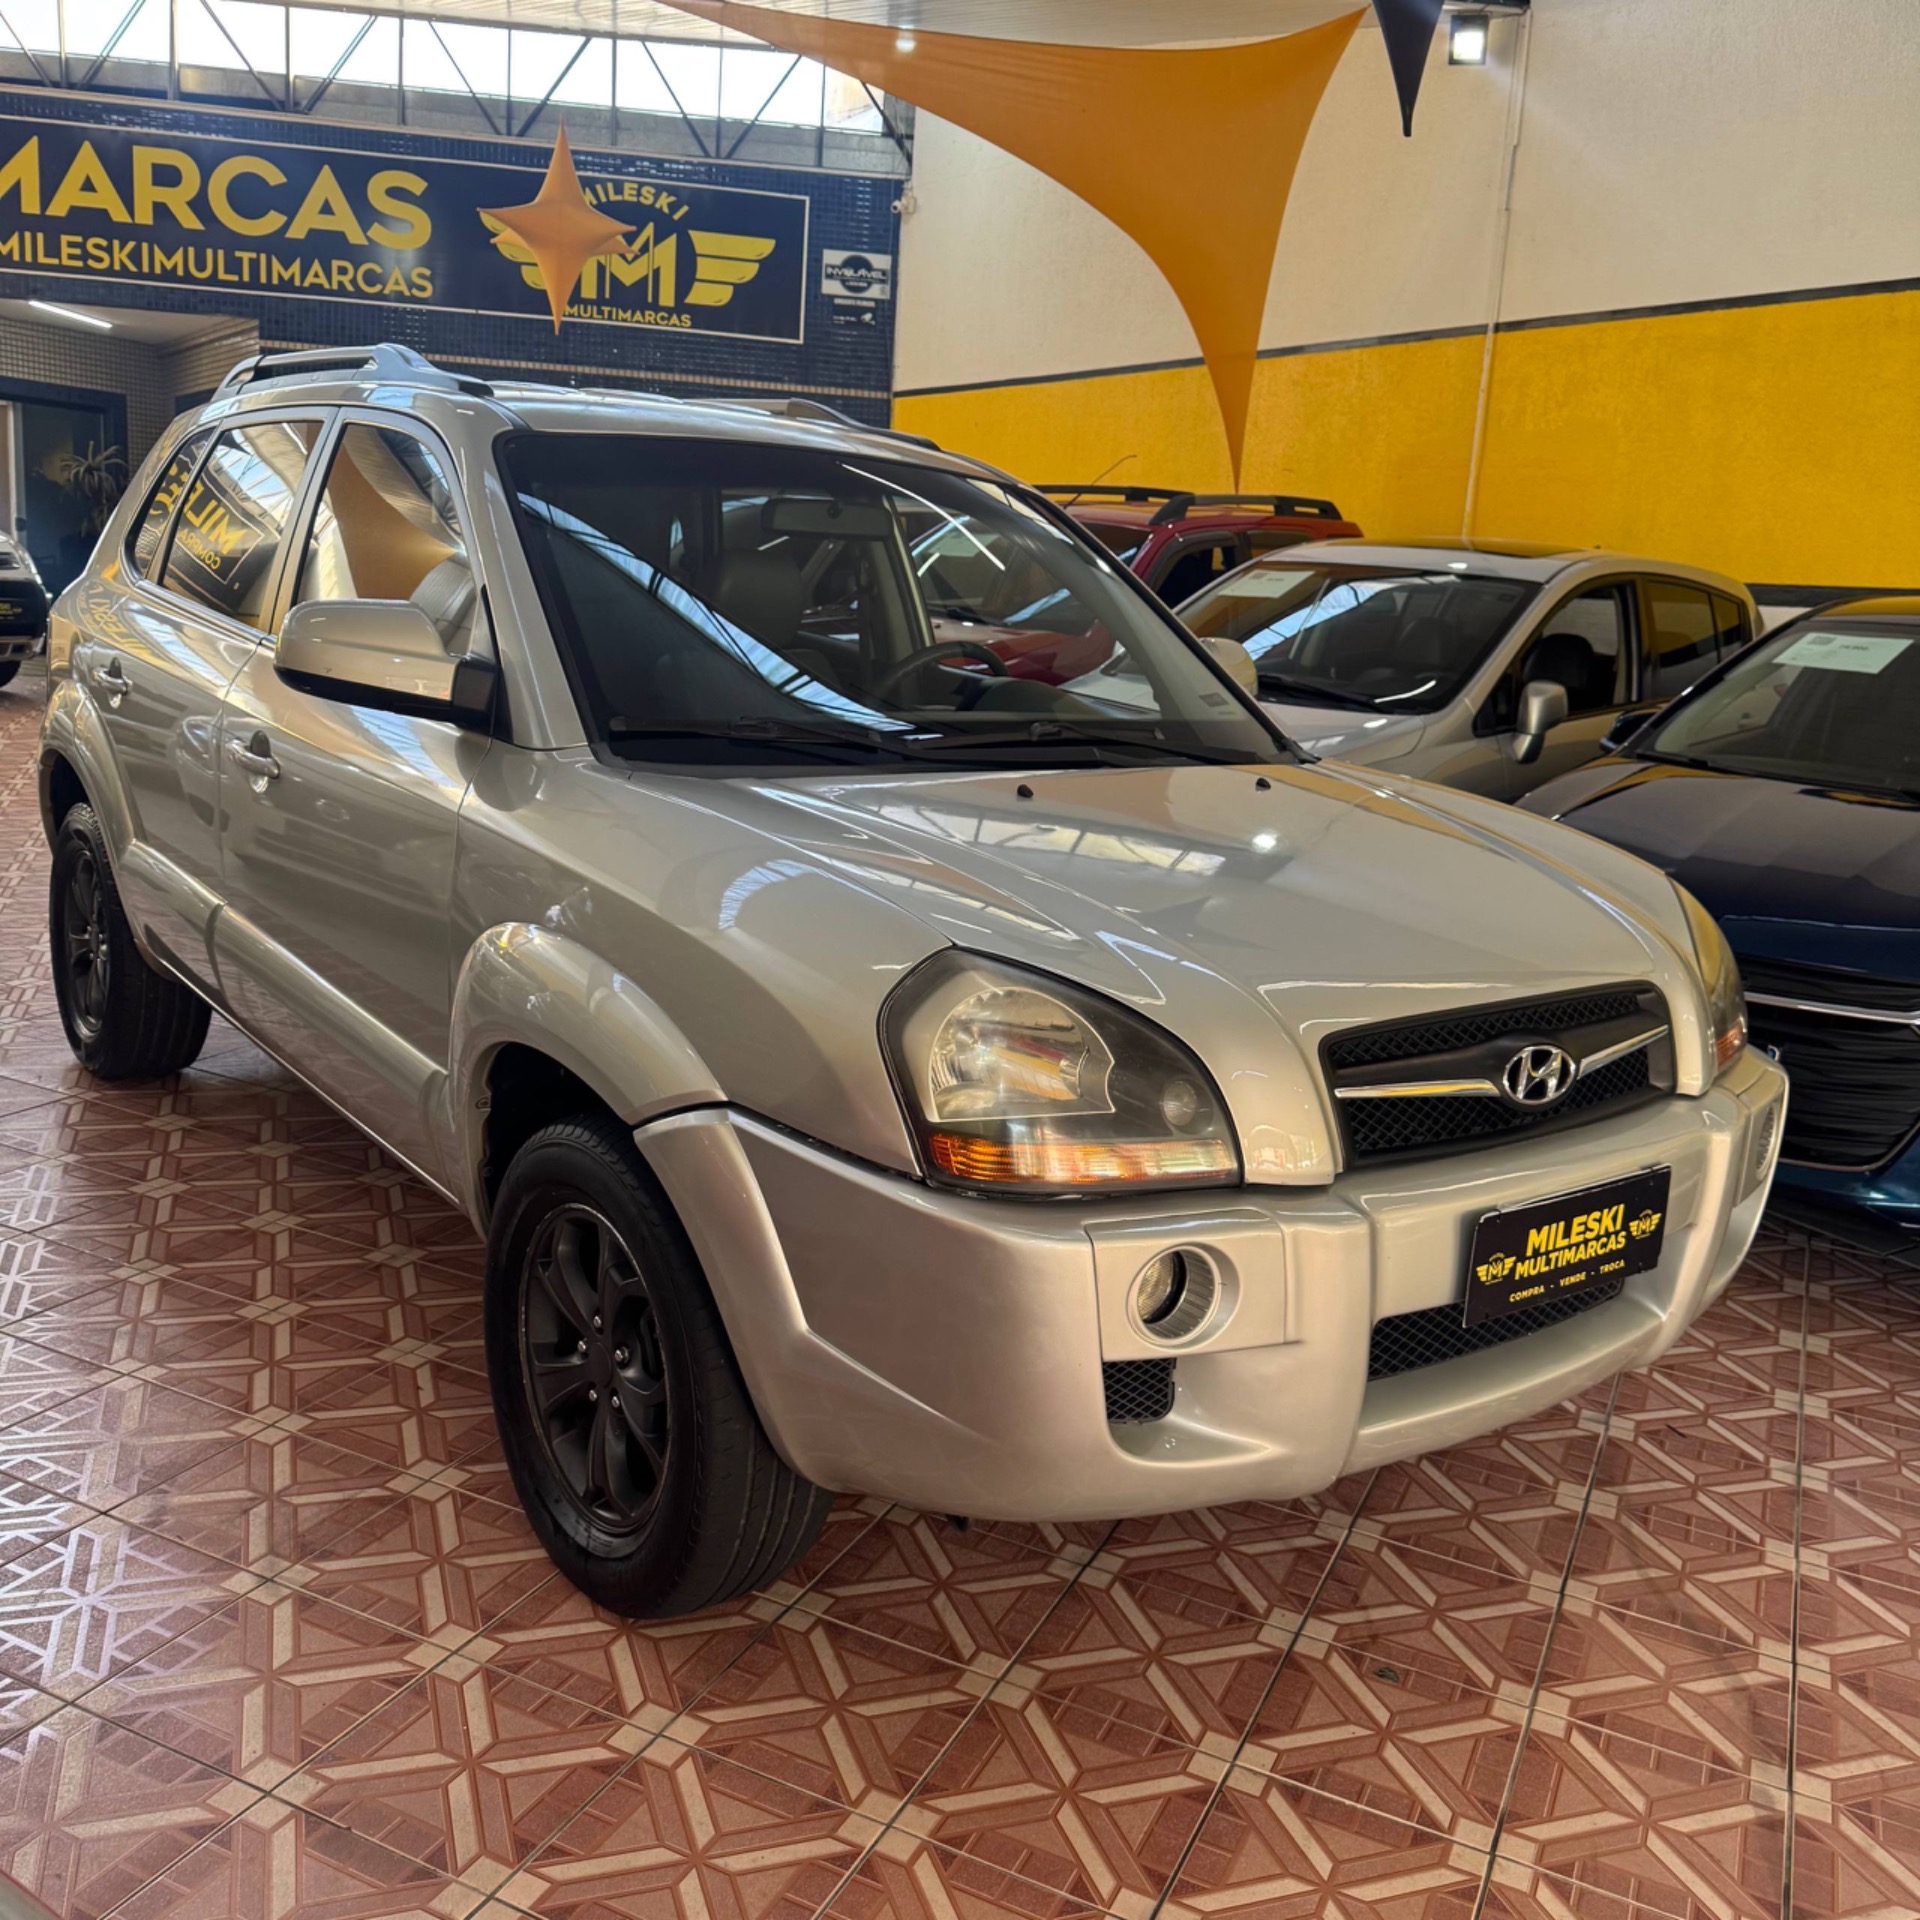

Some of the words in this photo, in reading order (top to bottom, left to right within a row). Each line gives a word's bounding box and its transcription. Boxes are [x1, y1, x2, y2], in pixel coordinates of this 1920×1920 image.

[565, 304, 692, 328] MULTIMARCAS
[1525, 1203, 1625, 1257] MILESKI
[1514, 1231, 1627, 1281] MULTIMARCAS
[1509, 1284, 1545, 1303] COMPRA
[1559, 1271, 1587, 1288] VENDE
[1599, 1259, 1625, 1275] TROCA
